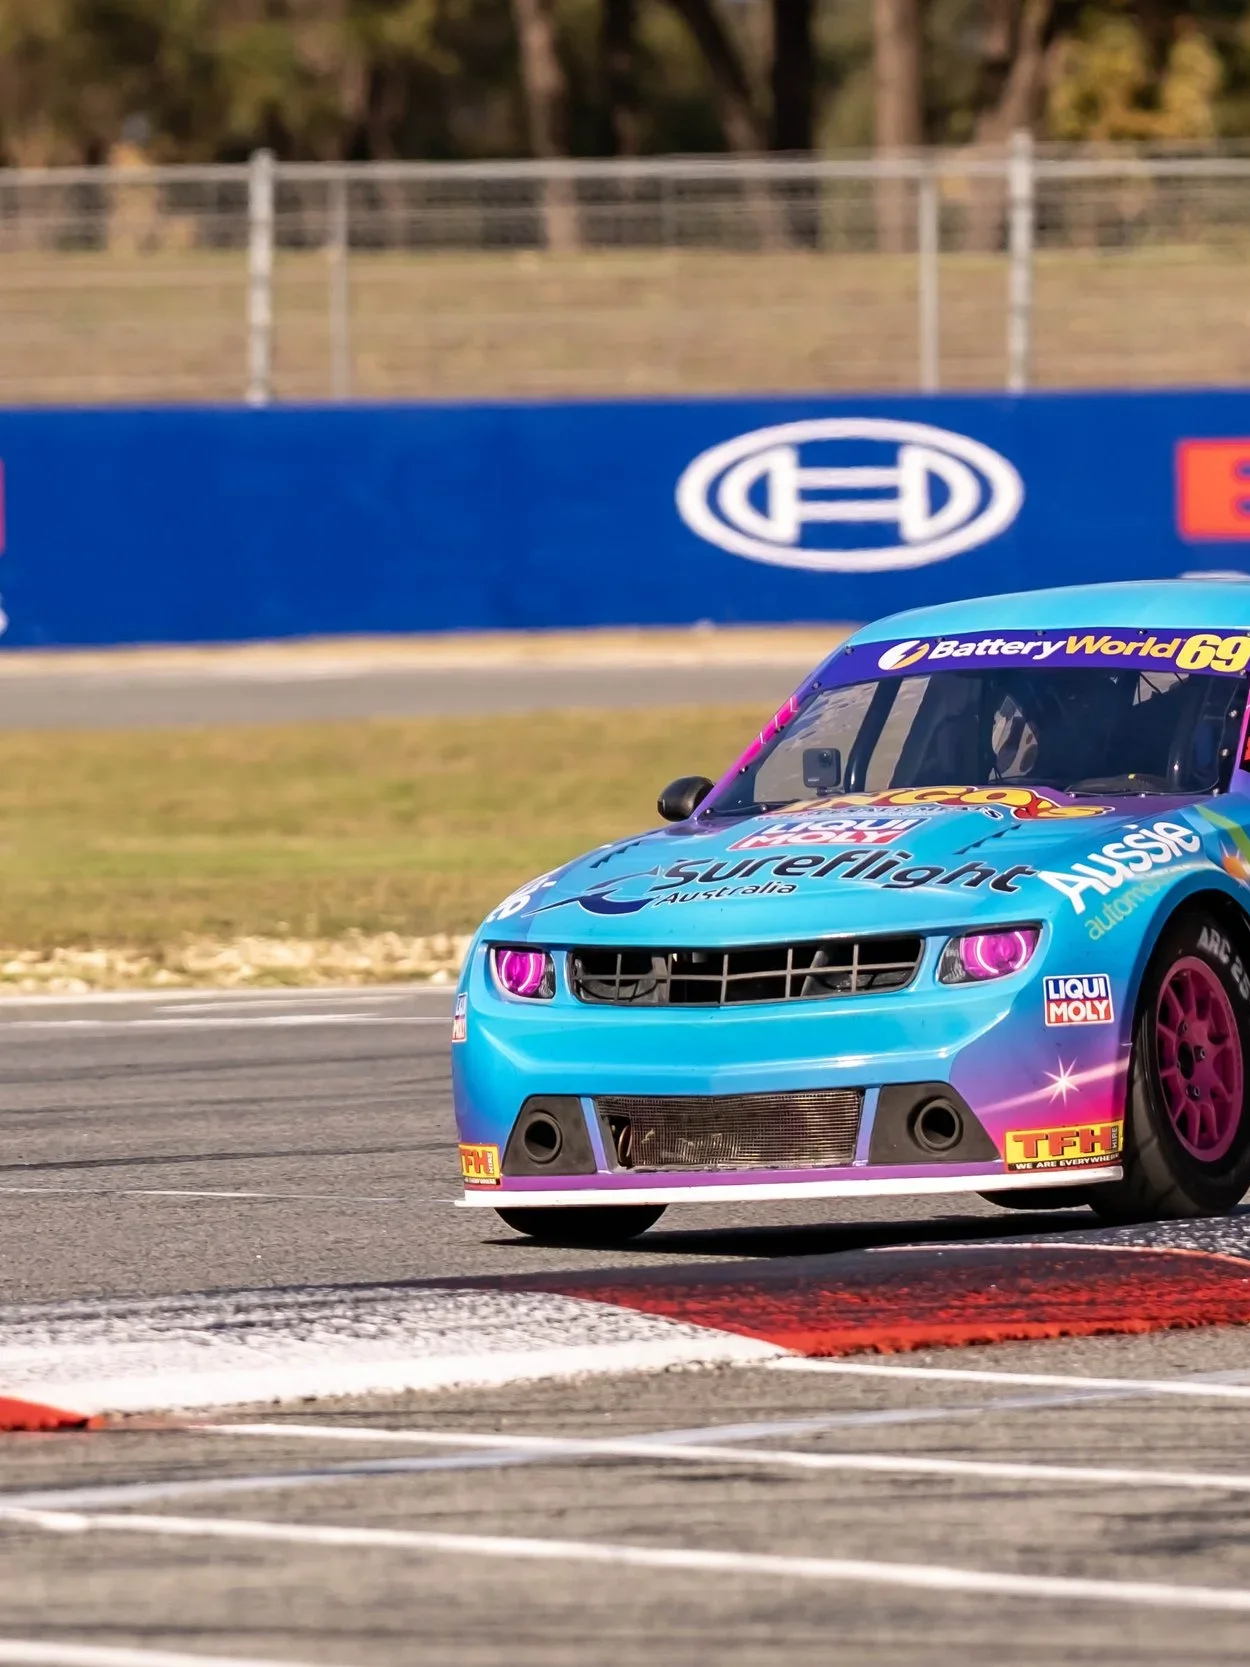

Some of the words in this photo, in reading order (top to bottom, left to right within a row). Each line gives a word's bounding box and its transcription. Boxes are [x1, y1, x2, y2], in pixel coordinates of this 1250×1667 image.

[763, 818, 916, 835] LIQUI
[738, 831, 902, 848] MOLY
[650, 849, 1038, 894] Sureflight
[1037, 821, 1200, 916] Aussie
[656, 880, 798, 906] Australia
[1048, 977, 1107, 1000] LIQUI
[1049, 1000, 1109, 1023] MOLY
[1013, 1126, 1112, 1159] TFH
[1111, 1125, 1119, 1150] HIRE
[1015, 1162, 1033, 1171] WE
[1036, 1160, 1057, 1170] ARE
